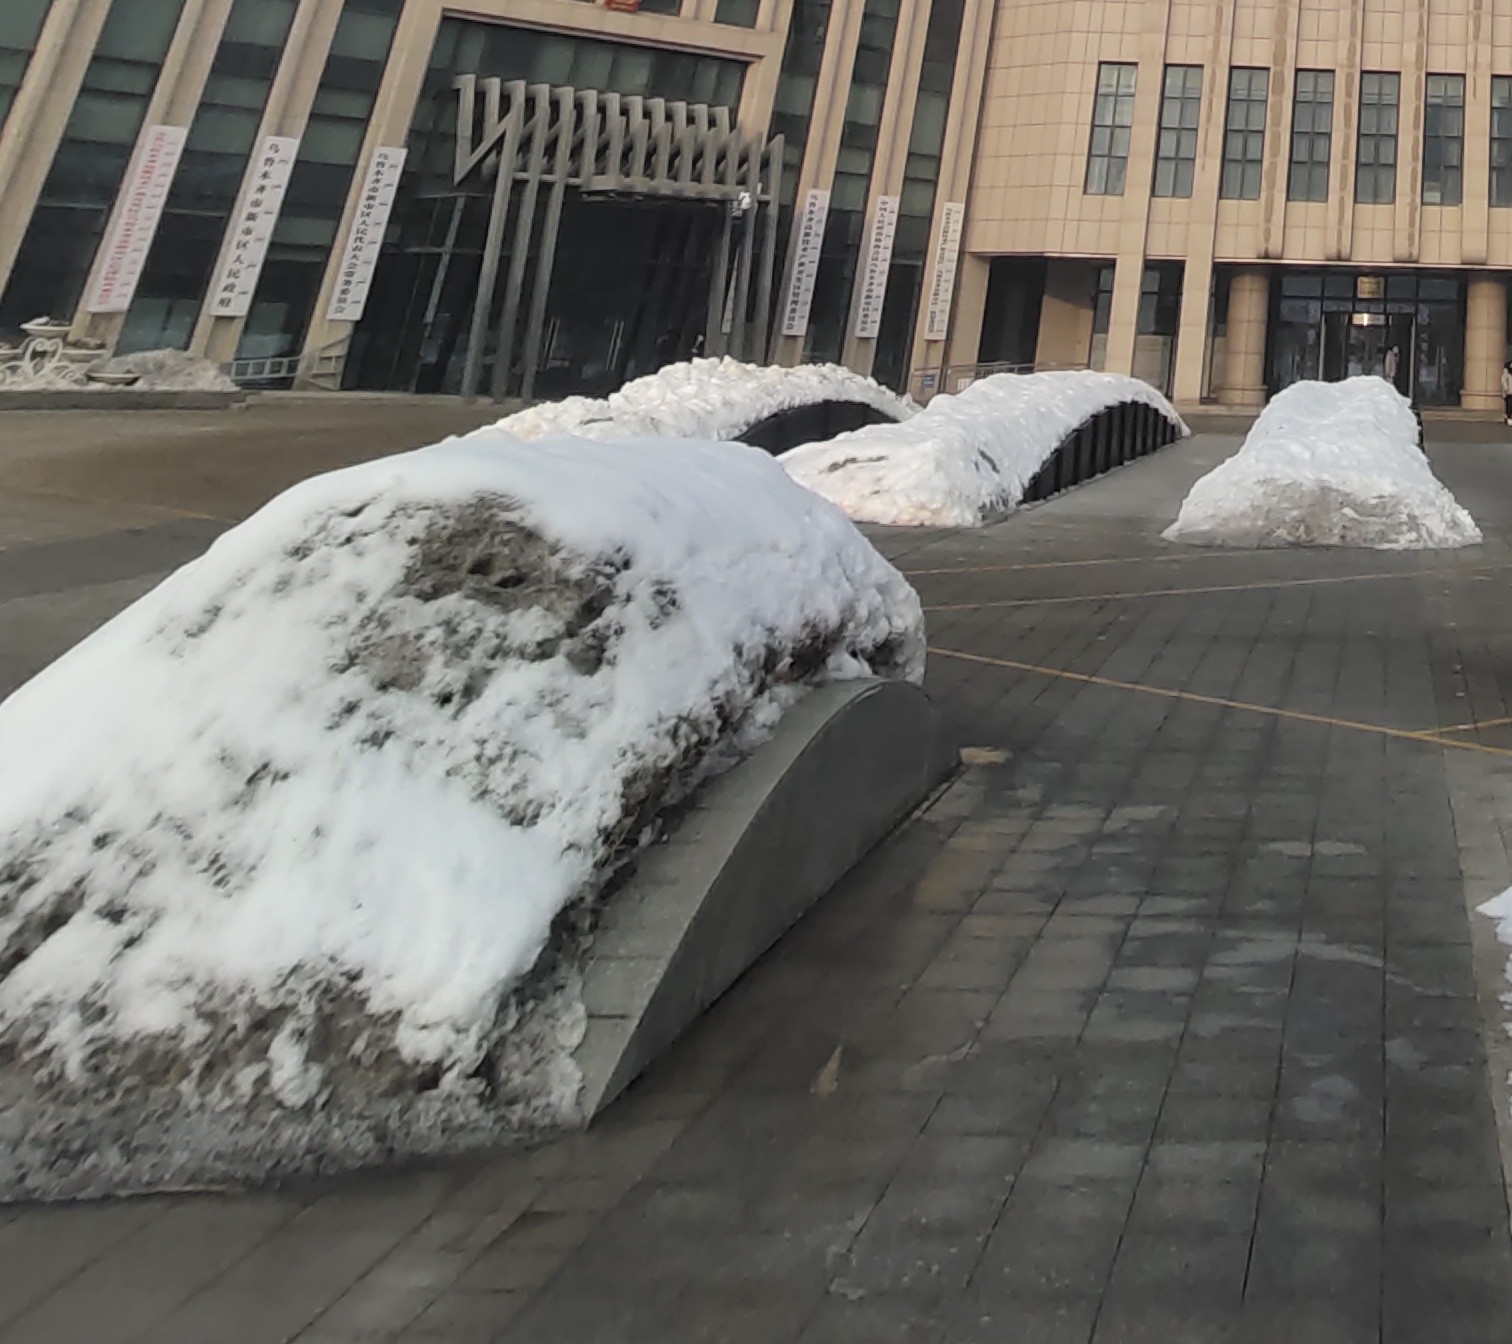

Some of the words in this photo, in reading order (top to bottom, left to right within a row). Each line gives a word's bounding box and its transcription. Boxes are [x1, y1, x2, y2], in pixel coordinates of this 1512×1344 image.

[218, 143, 280, 309] 乌鲁木齐市新市区人民政府
